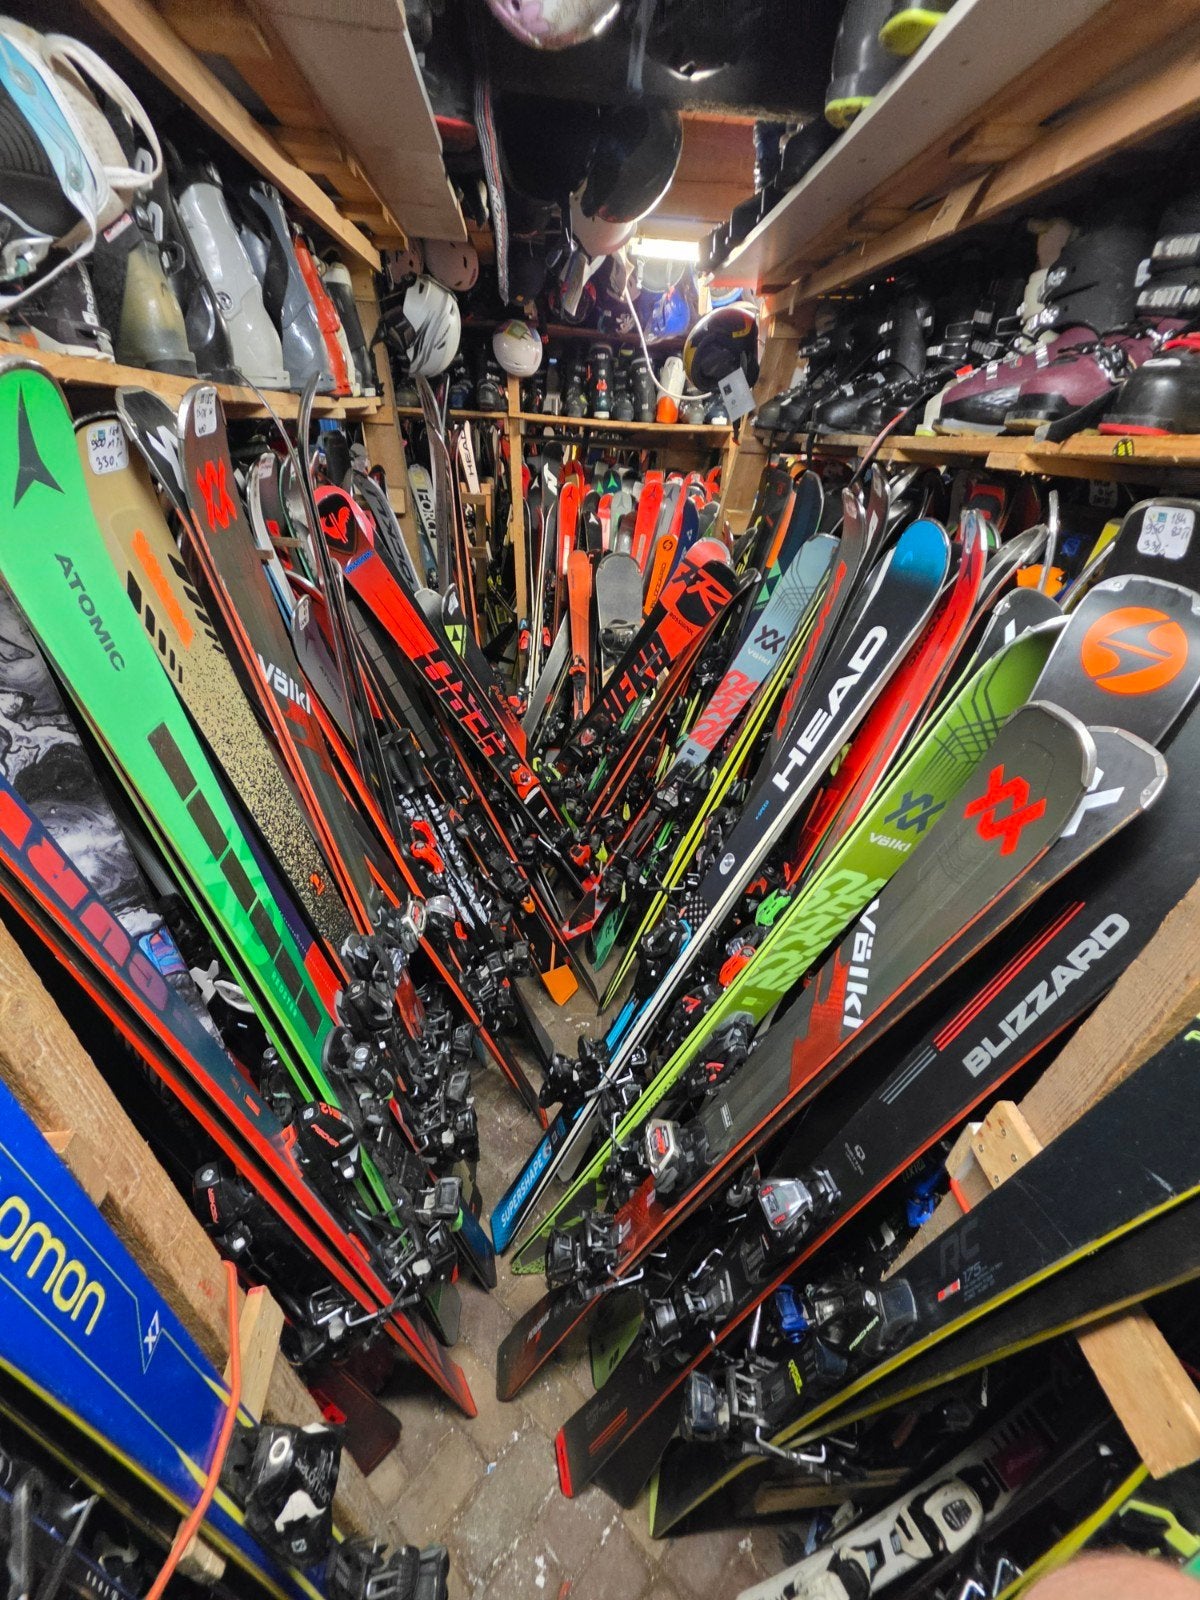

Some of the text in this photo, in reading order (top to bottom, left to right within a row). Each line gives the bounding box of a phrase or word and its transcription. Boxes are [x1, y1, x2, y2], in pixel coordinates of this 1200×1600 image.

[53, 553, 126, 672] ATOMIC
[257, 653, 311, 715] Völkl
[772, 625, 888, 792] HEAD
[869, 832, 912, 852] Völkl
[843, 898, 880, 1029] Völkl
[961, 913, 1131, 1078] BLIZZARD
[501, 1152, 543, 1228] SUPERSHAPE
[848, 1315, 880, 1352] FISCHER
